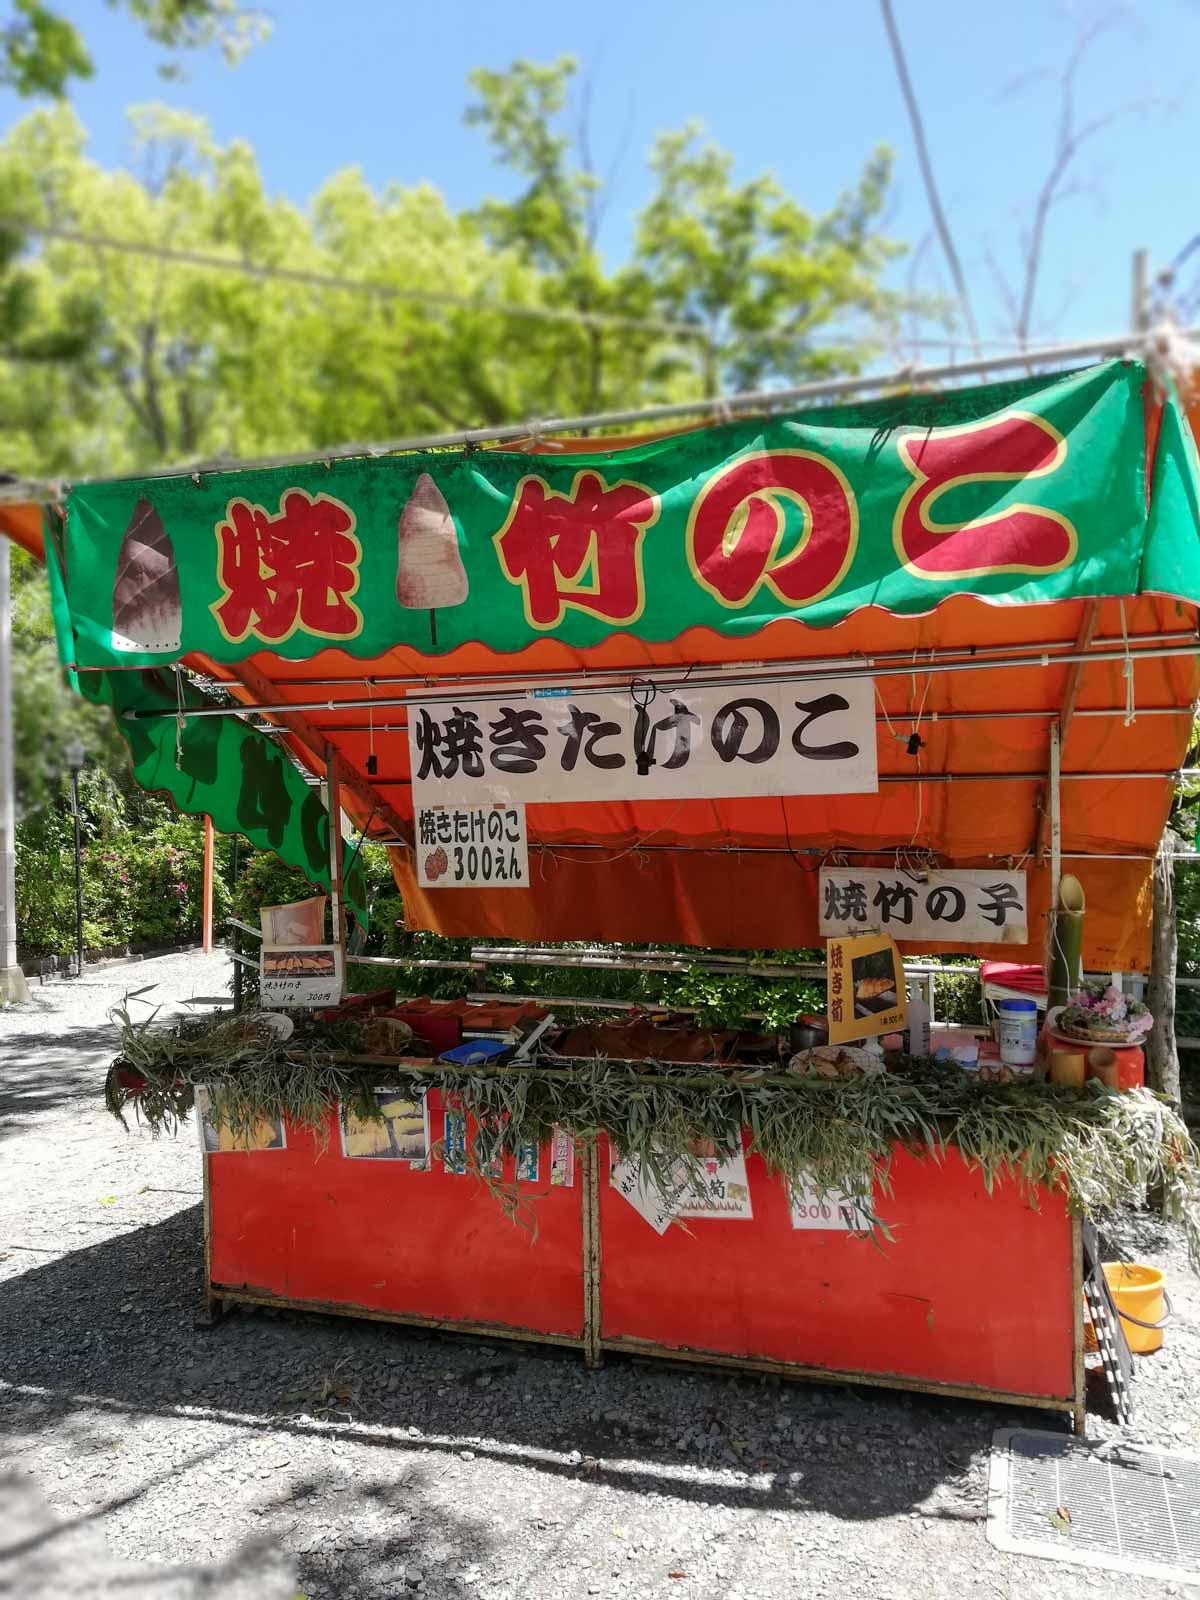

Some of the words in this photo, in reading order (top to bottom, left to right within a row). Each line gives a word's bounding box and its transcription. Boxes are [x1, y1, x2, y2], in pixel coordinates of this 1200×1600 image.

[208, 486, 364, 643] 焼
[491, 410, 1080, 630] 竹のこ
[416, 691, 861, 781] 焼きたけのこ
[419, 808, 521, 846] 焼きたけのこ
[454, 846, 522, 881] 300えん
[824, 878, 1024, 926] 焼竹の子
[831, 944, 843, 1023] 焼き筍
